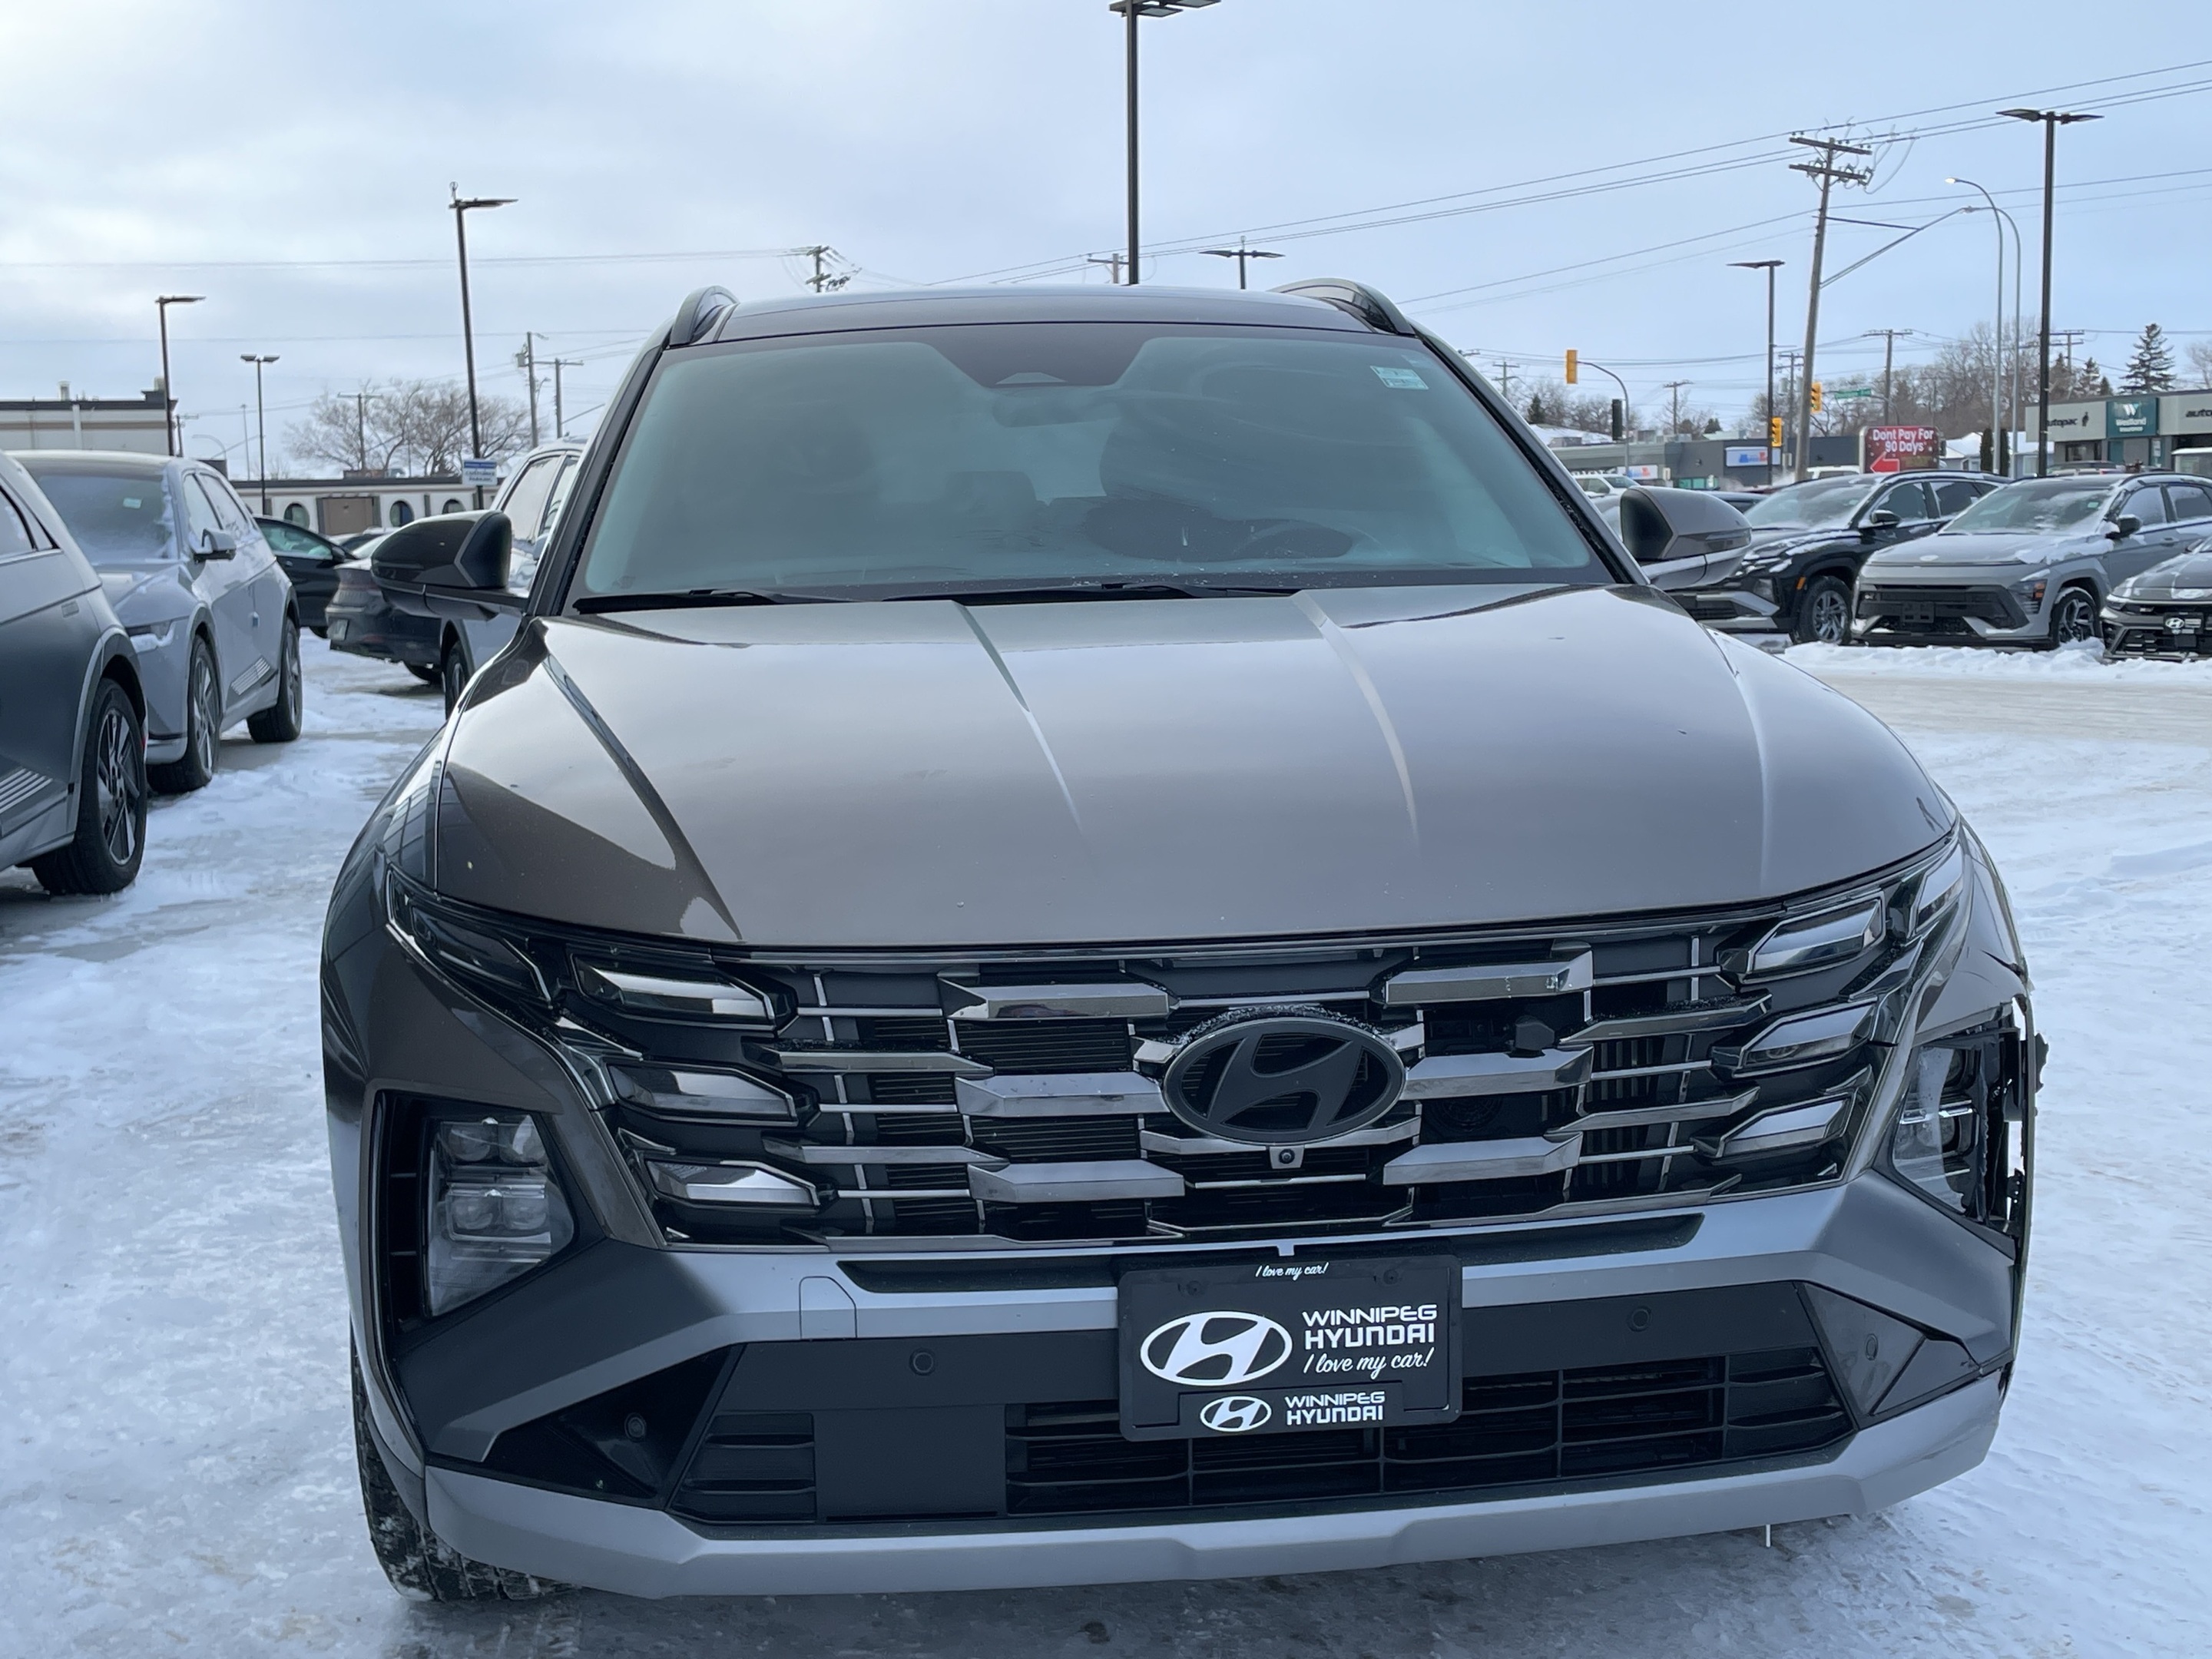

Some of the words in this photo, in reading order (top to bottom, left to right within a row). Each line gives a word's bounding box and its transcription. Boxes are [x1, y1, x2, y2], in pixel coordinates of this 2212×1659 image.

[2047, 417, 2078, 428] utopac
[1898, 429, 1917, 443] Pay
[1918, 428, 1934, 439] For
[1885, 441, 1898, 452] 90
[1899, 441, 1925, 455] Days
[1255, 1265, 1263, 1277] I
[1262, 1265, 1283, 1277] love
[1285, 1267, 1303, 1281] my
[1304, 1261, 1329, 1275] car!
[1302, 1304, 1437, 1327] WINNIPEG
[1305, 1323, 1435, 1350] HYUNDAI
[1303, 1353, 1315, 1373] I
[1316, 1353, 1353, 1373] love
[1356, 1356, 1386, 1379] my
[1390, 1346, 1435, 1369] car!
[1284, 1391, 1386, 1409] WINNIPEG
[1286, 1405, 1383, 1426] HYUNDAI
